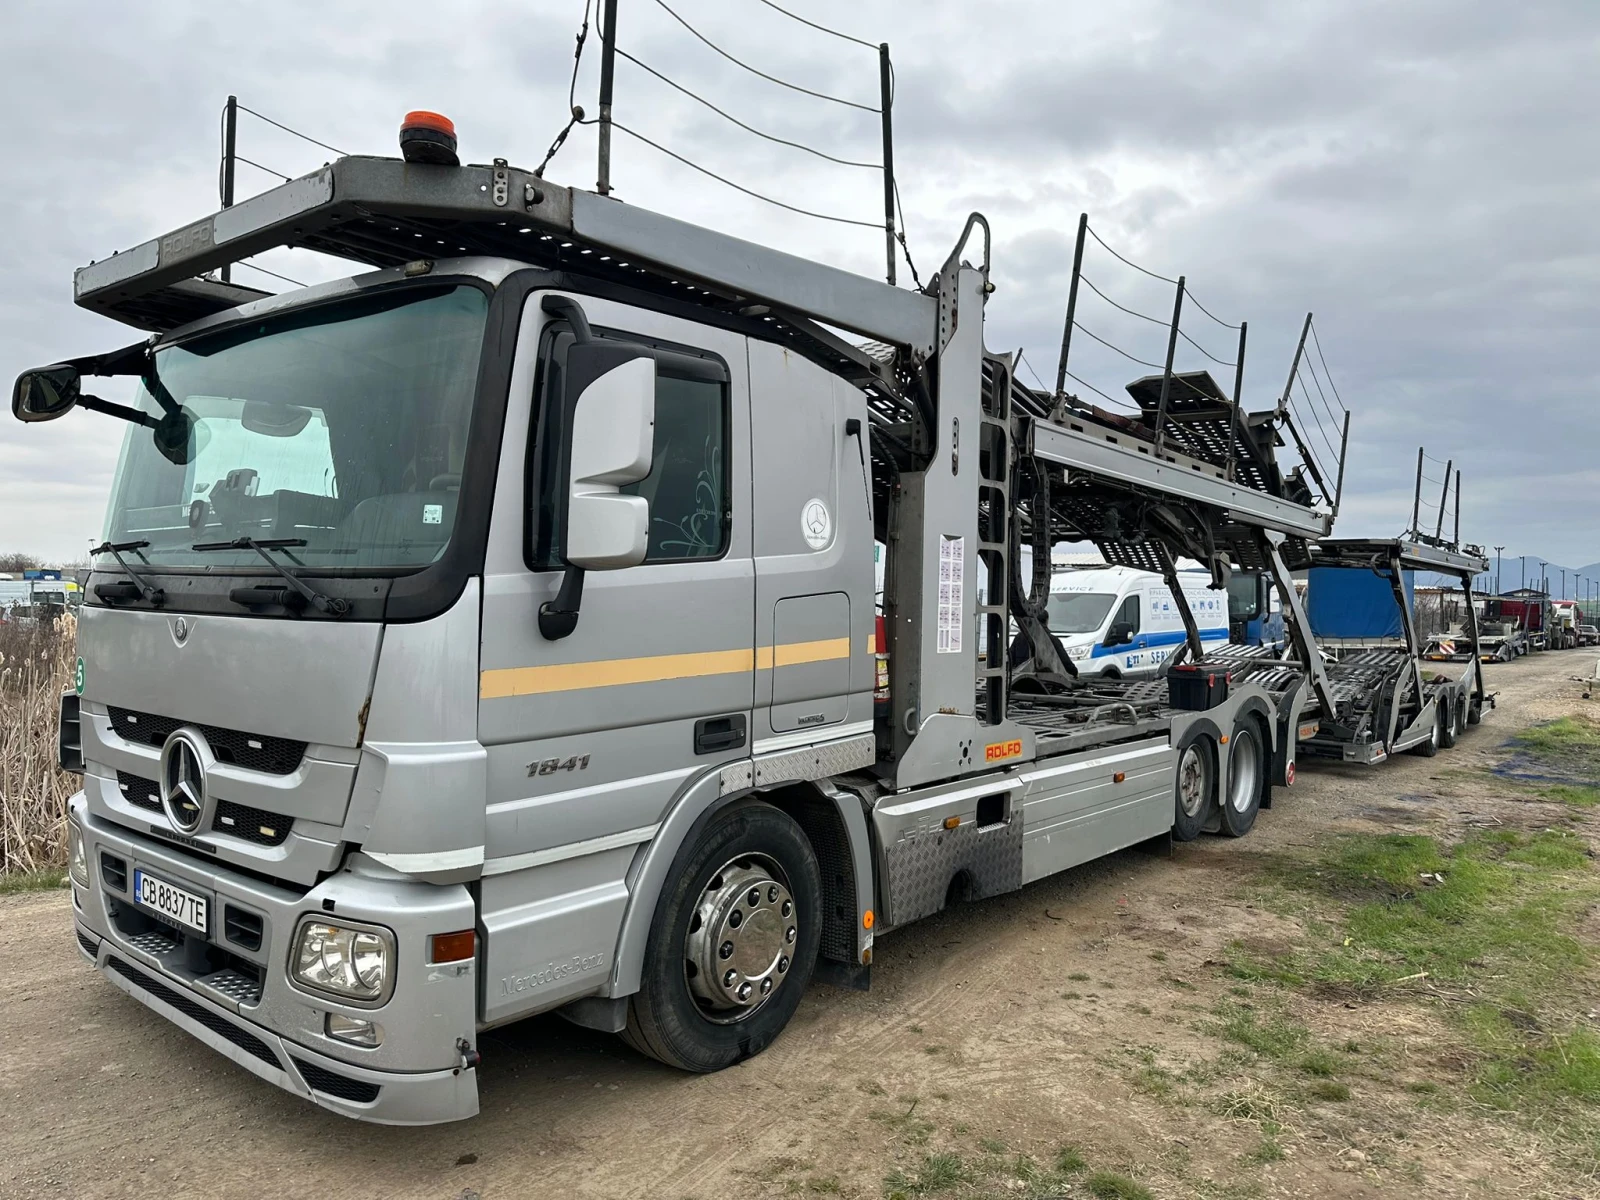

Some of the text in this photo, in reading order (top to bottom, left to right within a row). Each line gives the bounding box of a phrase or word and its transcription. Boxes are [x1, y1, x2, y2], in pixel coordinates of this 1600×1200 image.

[163, 224, 212, 259] ROLFO
[77, 665, 83, 686] 5
[526, 753, 591, 778] 1841
[986, 742, 1021, 759] ROLFO
[142, 877, 156, 905] CB
[158, 884, 186, 918] 8837
[187, 896, 204, 928] TE
[501, 953, 604, 998] Mercedes-Benz
